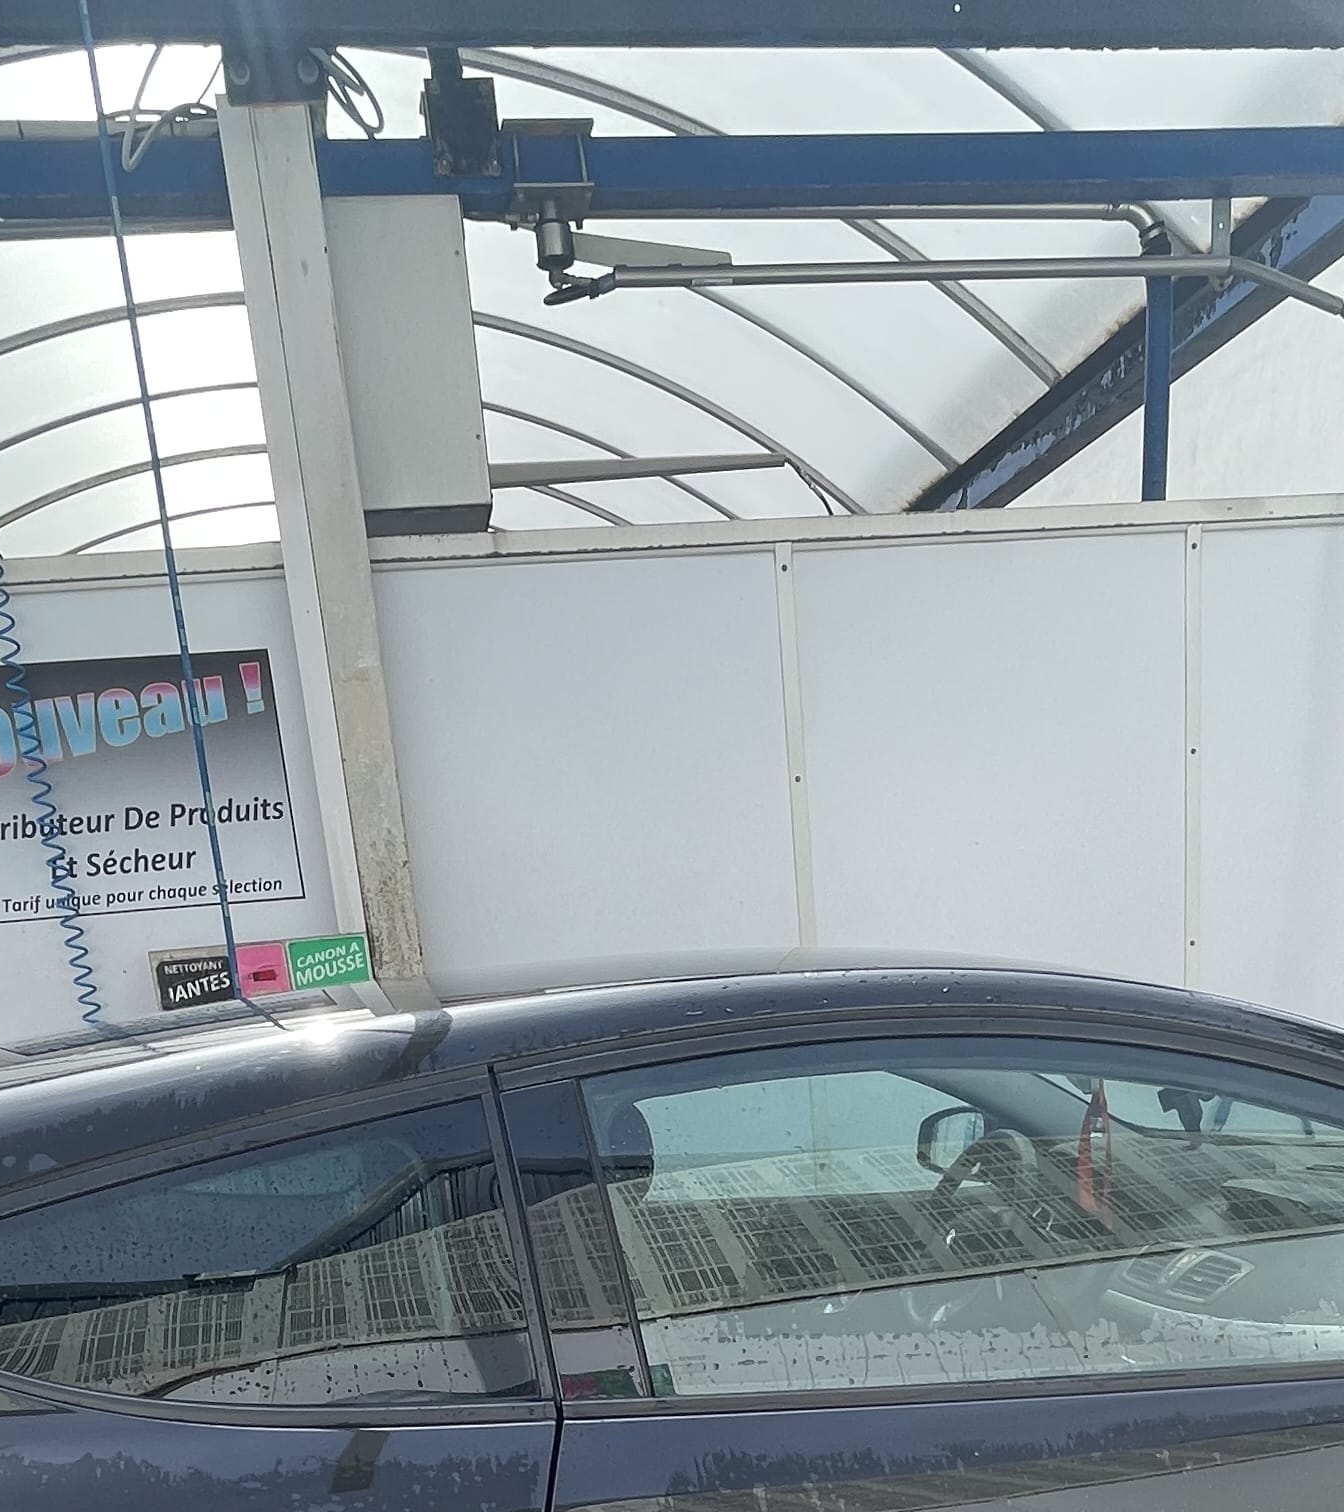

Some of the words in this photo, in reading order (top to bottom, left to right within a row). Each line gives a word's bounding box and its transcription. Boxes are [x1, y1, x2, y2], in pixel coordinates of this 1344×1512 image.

[239, 662, 264, 714] !
[125, 806, 160, 830] De
[50, 857, 78, 879] Et
[87, 848, 196, 876] Sécheur
[3, 895, 42, 914] Tarif
[106, 887, 144, 906] pour
[148, 883, 207, 900] chaque
[164, 961, 224, 975] NETTOYANT
[296, 947, 346, 968] CANON
[345, 942, 360, 952] A
[296, 953, 365, 986] MOUSSE
